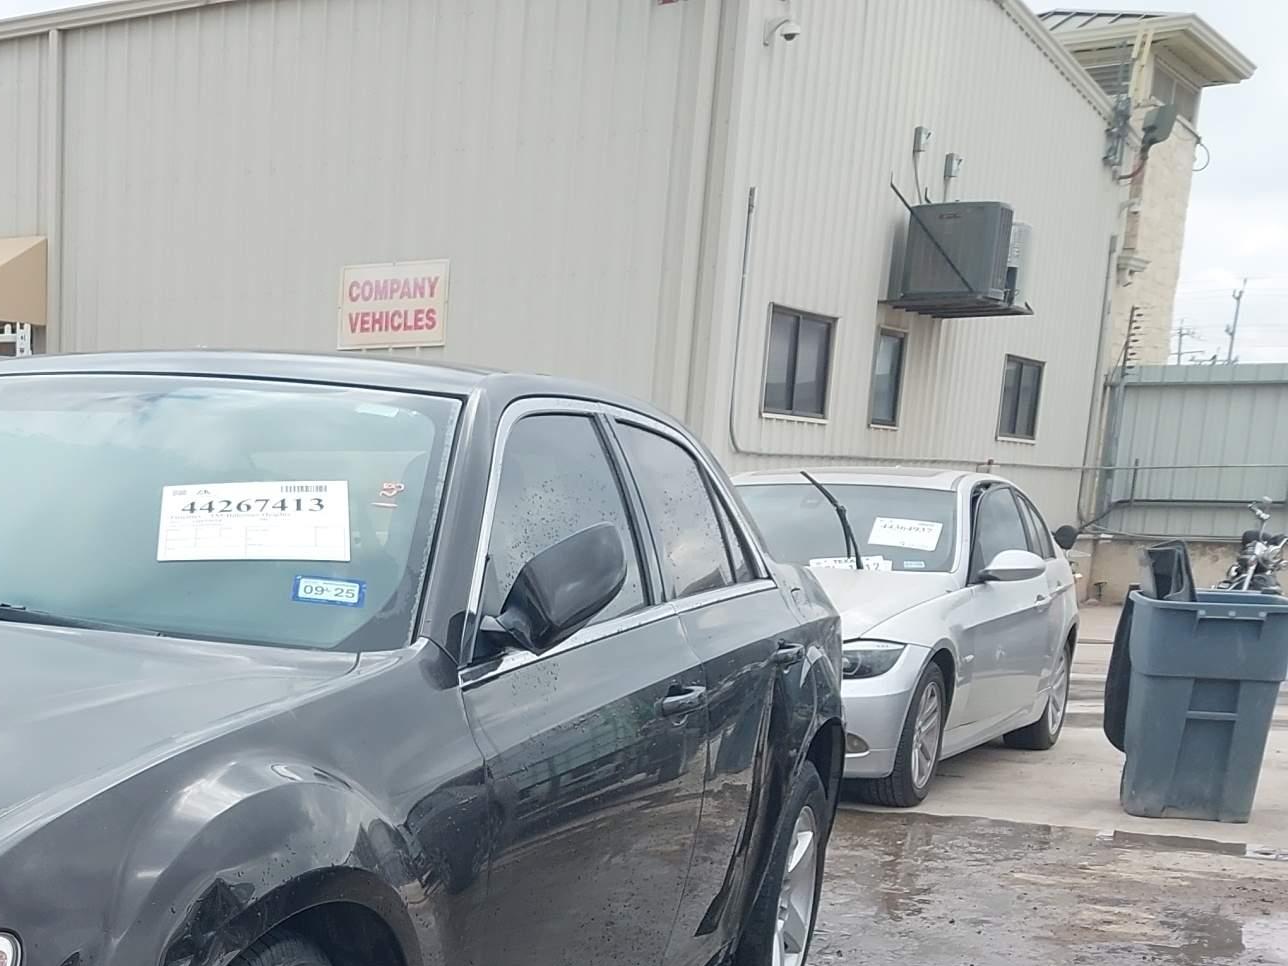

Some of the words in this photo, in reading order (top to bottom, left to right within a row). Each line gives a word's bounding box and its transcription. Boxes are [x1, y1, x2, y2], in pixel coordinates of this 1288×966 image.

[348, 276, 440, 302] COMPANY
[348, 308, 437, 334] VEHICLES
[181, 498, 325, 514] 44267413
